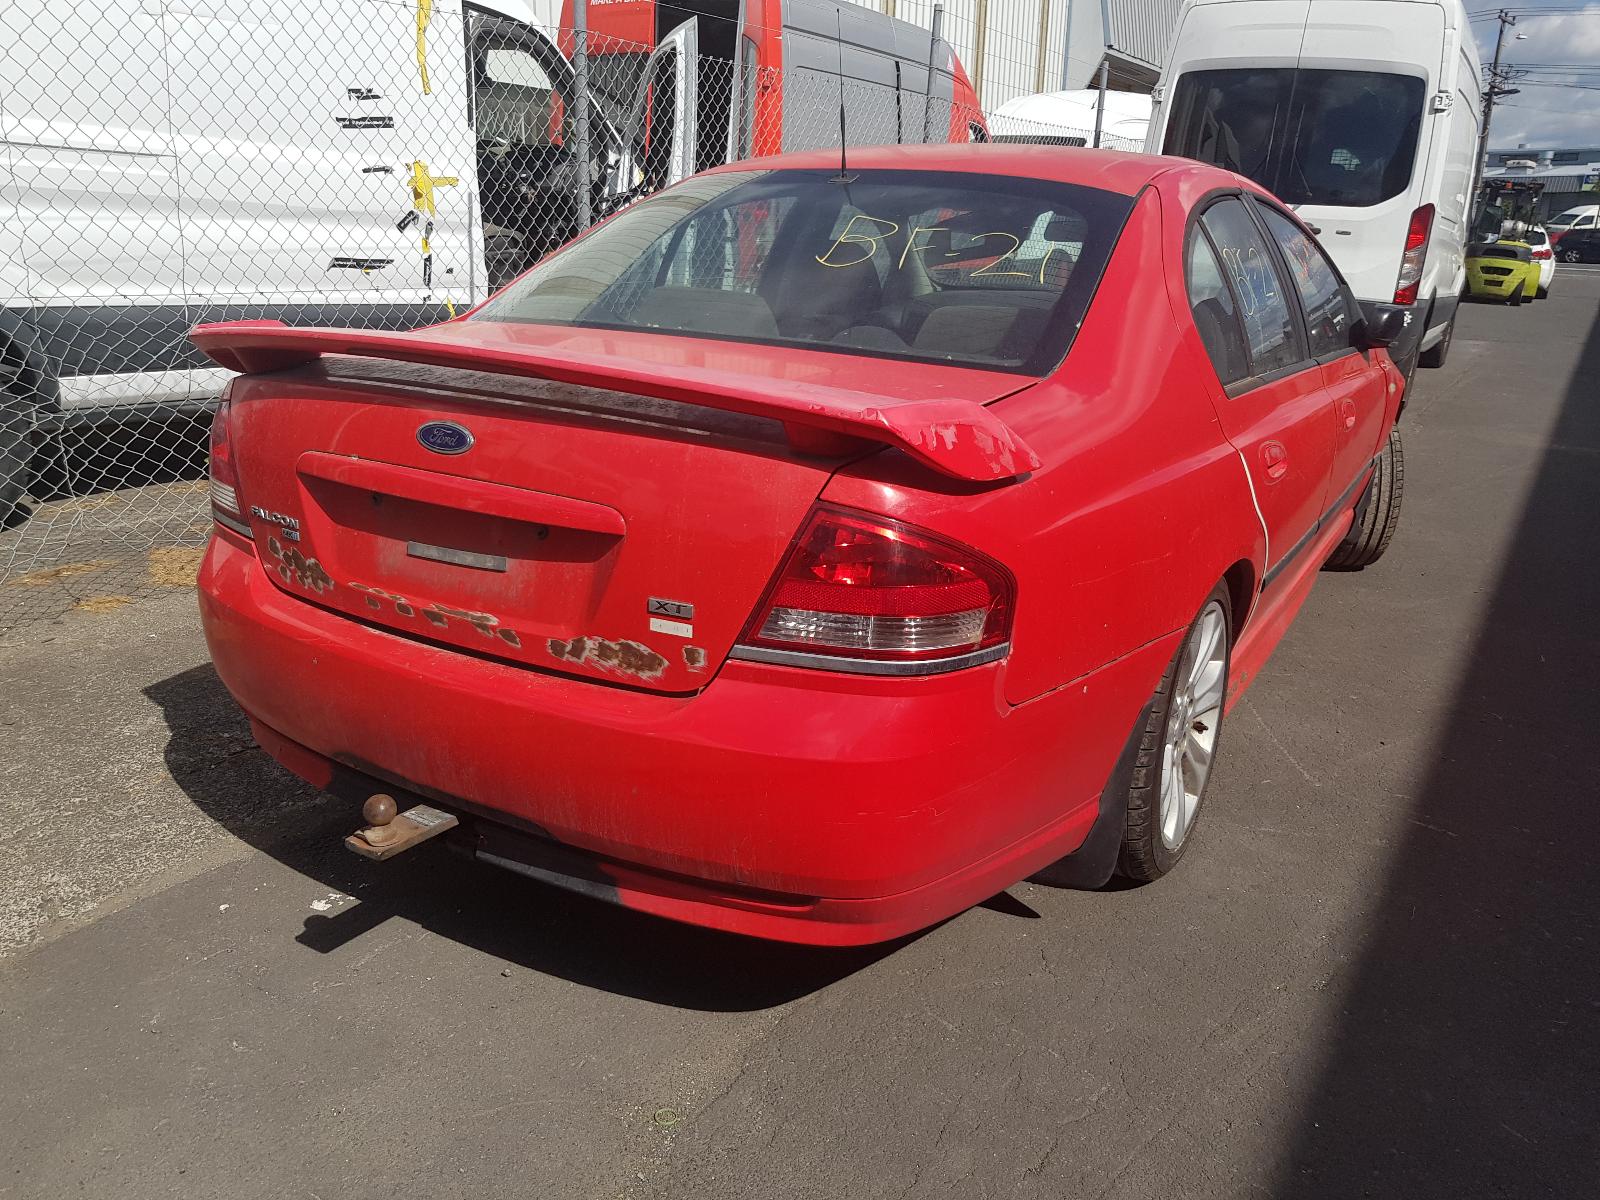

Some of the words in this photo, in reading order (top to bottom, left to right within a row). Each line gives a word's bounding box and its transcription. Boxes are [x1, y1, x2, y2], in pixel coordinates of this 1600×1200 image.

[429, 428, 459, 446] Ford
[251, 505, 299, 530] FALCON
[655, 600, 688, 615] XT
